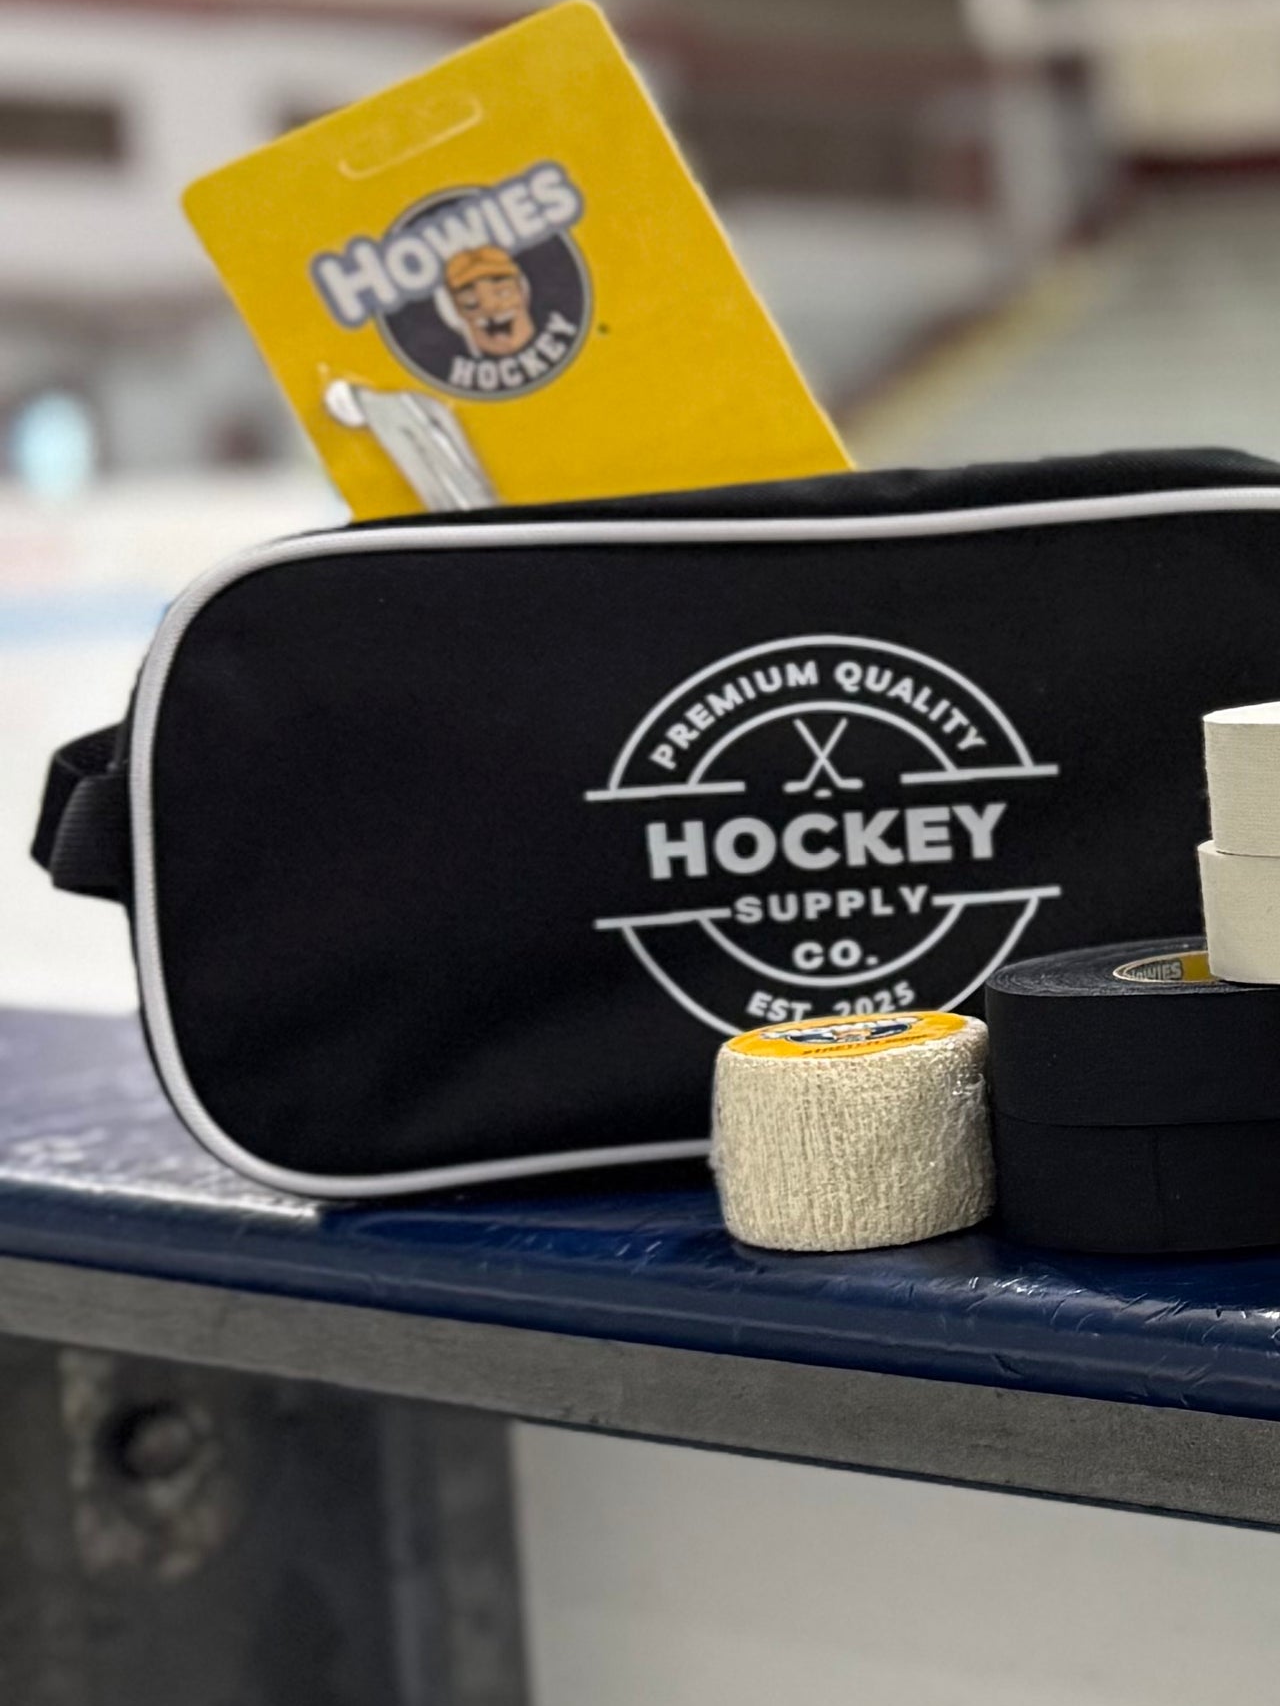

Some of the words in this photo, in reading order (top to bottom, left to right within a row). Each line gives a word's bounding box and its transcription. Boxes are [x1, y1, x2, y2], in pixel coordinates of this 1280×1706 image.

[318, 166, 580, 324] HOWIES
[449, 314, 577, 389] HOCKEY
[650, 660, 818, 770] PREMIUM
[834, 661, 987, 759] QUALITY
[647, 803, 1008, 879] HOCKEY
[734, 886, 929, 924] SUPPLY
[791, 940, 879, 970] CO.
[832, 981, 915, 1017] 2025
